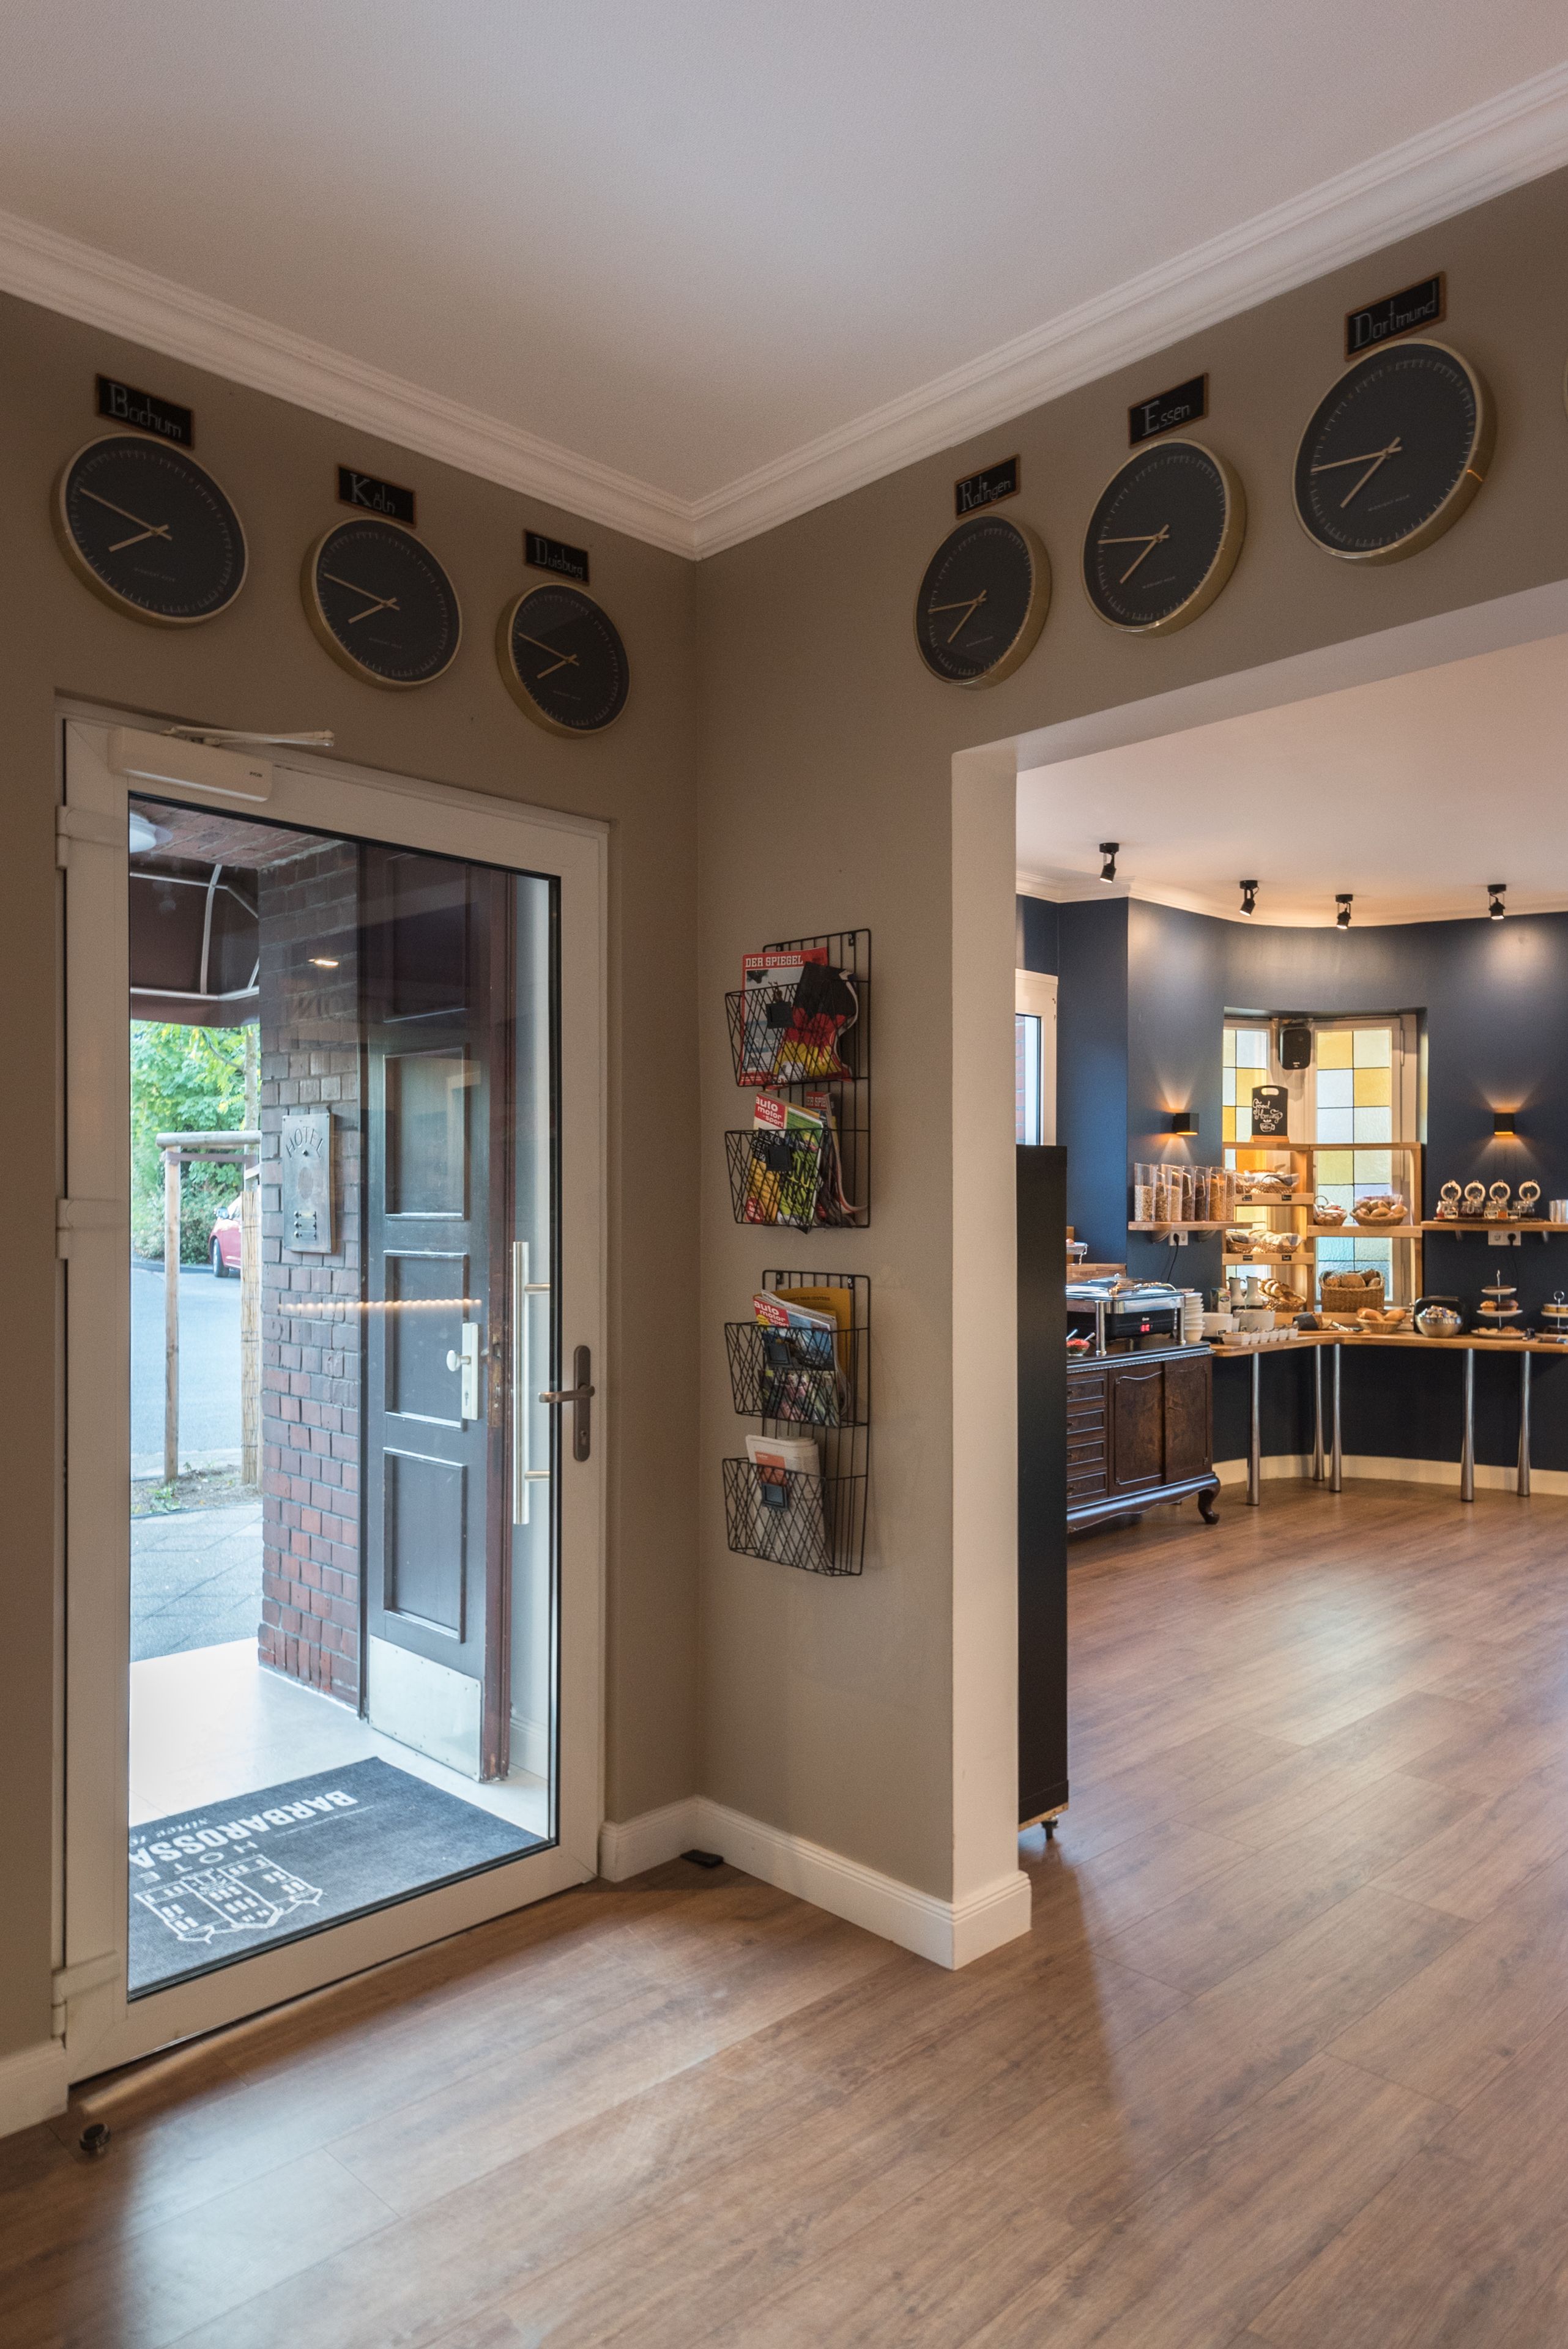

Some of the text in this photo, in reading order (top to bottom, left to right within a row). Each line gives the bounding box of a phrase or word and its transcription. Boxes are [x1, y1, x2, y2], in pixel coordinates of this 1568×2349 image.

[1353, 281, 1436, 348] Dortmund
[108, 382, 182, 439] Bochum
[1140, 400, 1191, 436] Essen
[349, 473, 396, 514] Köln
[959, 475, 1011, 511] Ratingen
[533, 536, 583, 581] Duisburg
[745, 955, 803, 968] DER SPIEGEL
[756, 1096, 778, 1112] auto
[757, 1106, 782, 1119] motor
[1253, 1098, 1271, 1114] Good
[286, 1126, 323, 1160] HOTEL
[753, 1300, 779, 1315] auto
[759, 1310, 786, 1322] motor
[129, 1790, 359, 1869] BARBAROSSA
[137, 1841, 259, 1885] HOTE
